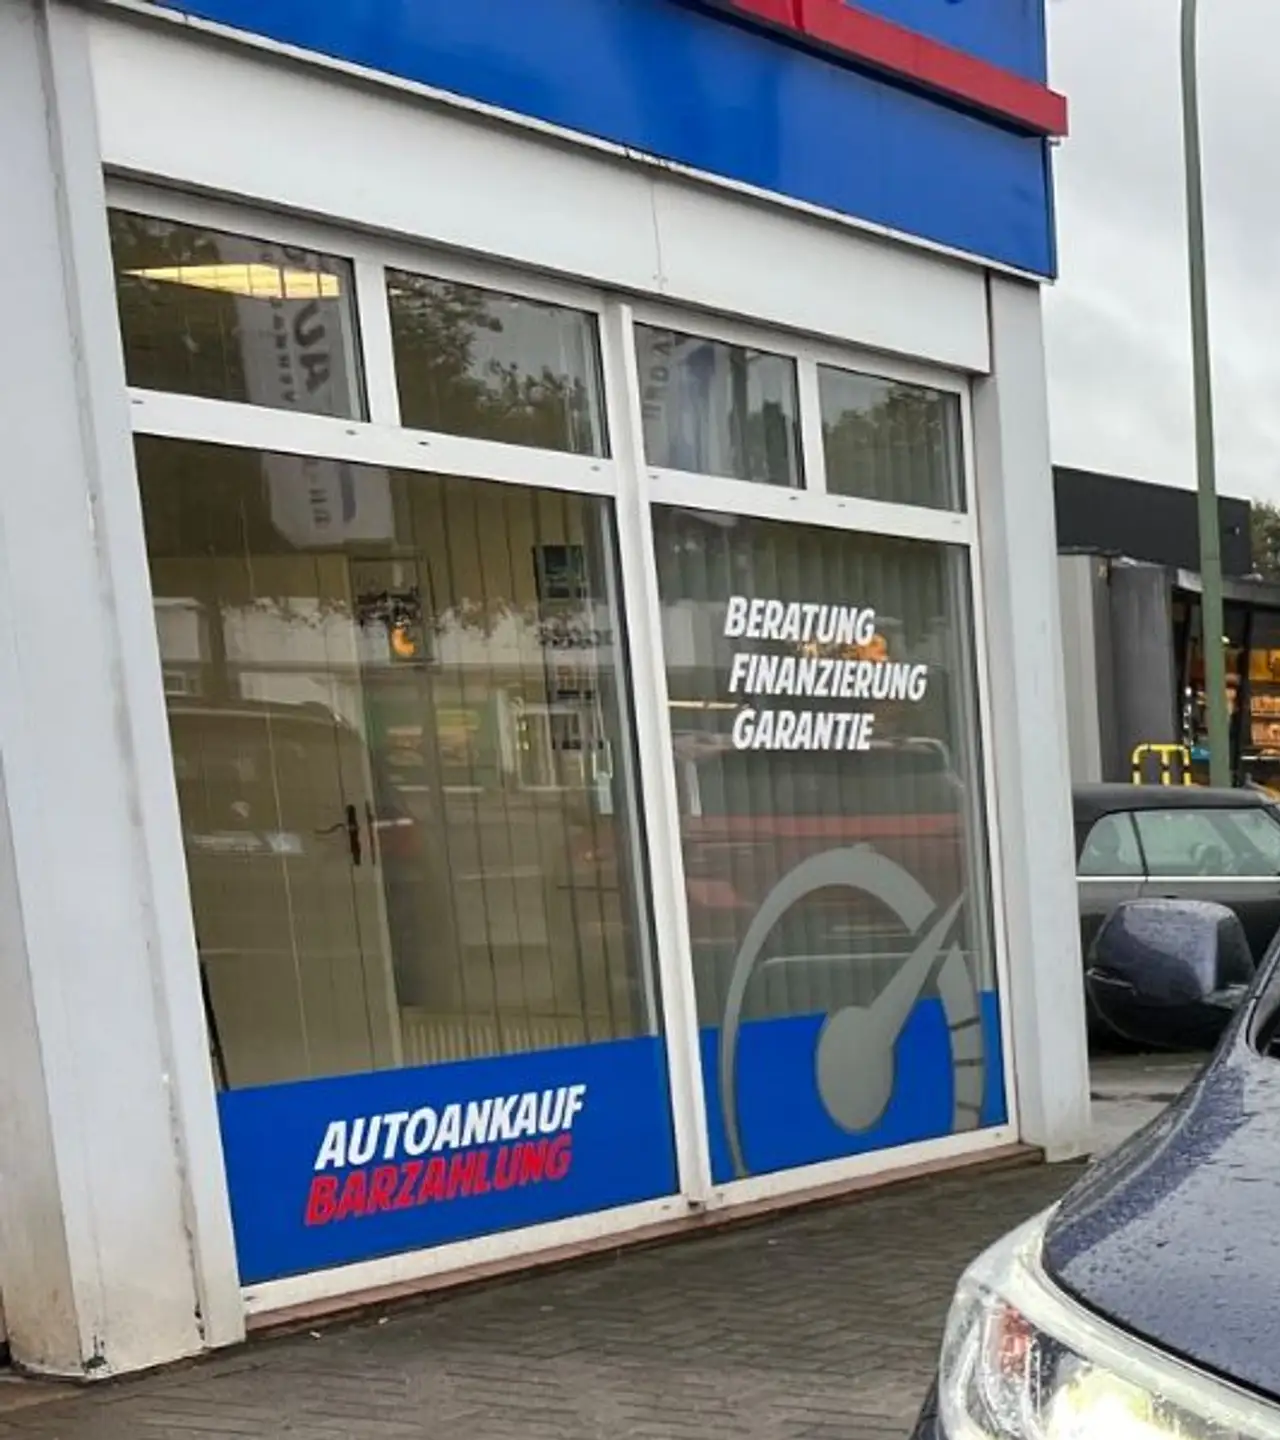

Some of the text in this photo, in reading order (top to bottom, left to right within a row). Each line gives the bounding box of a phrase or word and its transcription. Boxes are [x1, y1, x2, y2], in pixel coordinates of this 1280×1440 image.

[724, 596, 875, 646] BERATUNG
[728, 653, 927, 701] FINANZIERUNG
[732, 708, 875, 751] GARANTIE
[314, 1084, 587, 1170] AUTOANKAUF
[305, 1132, 573, 1227] BARZAHLUNG
